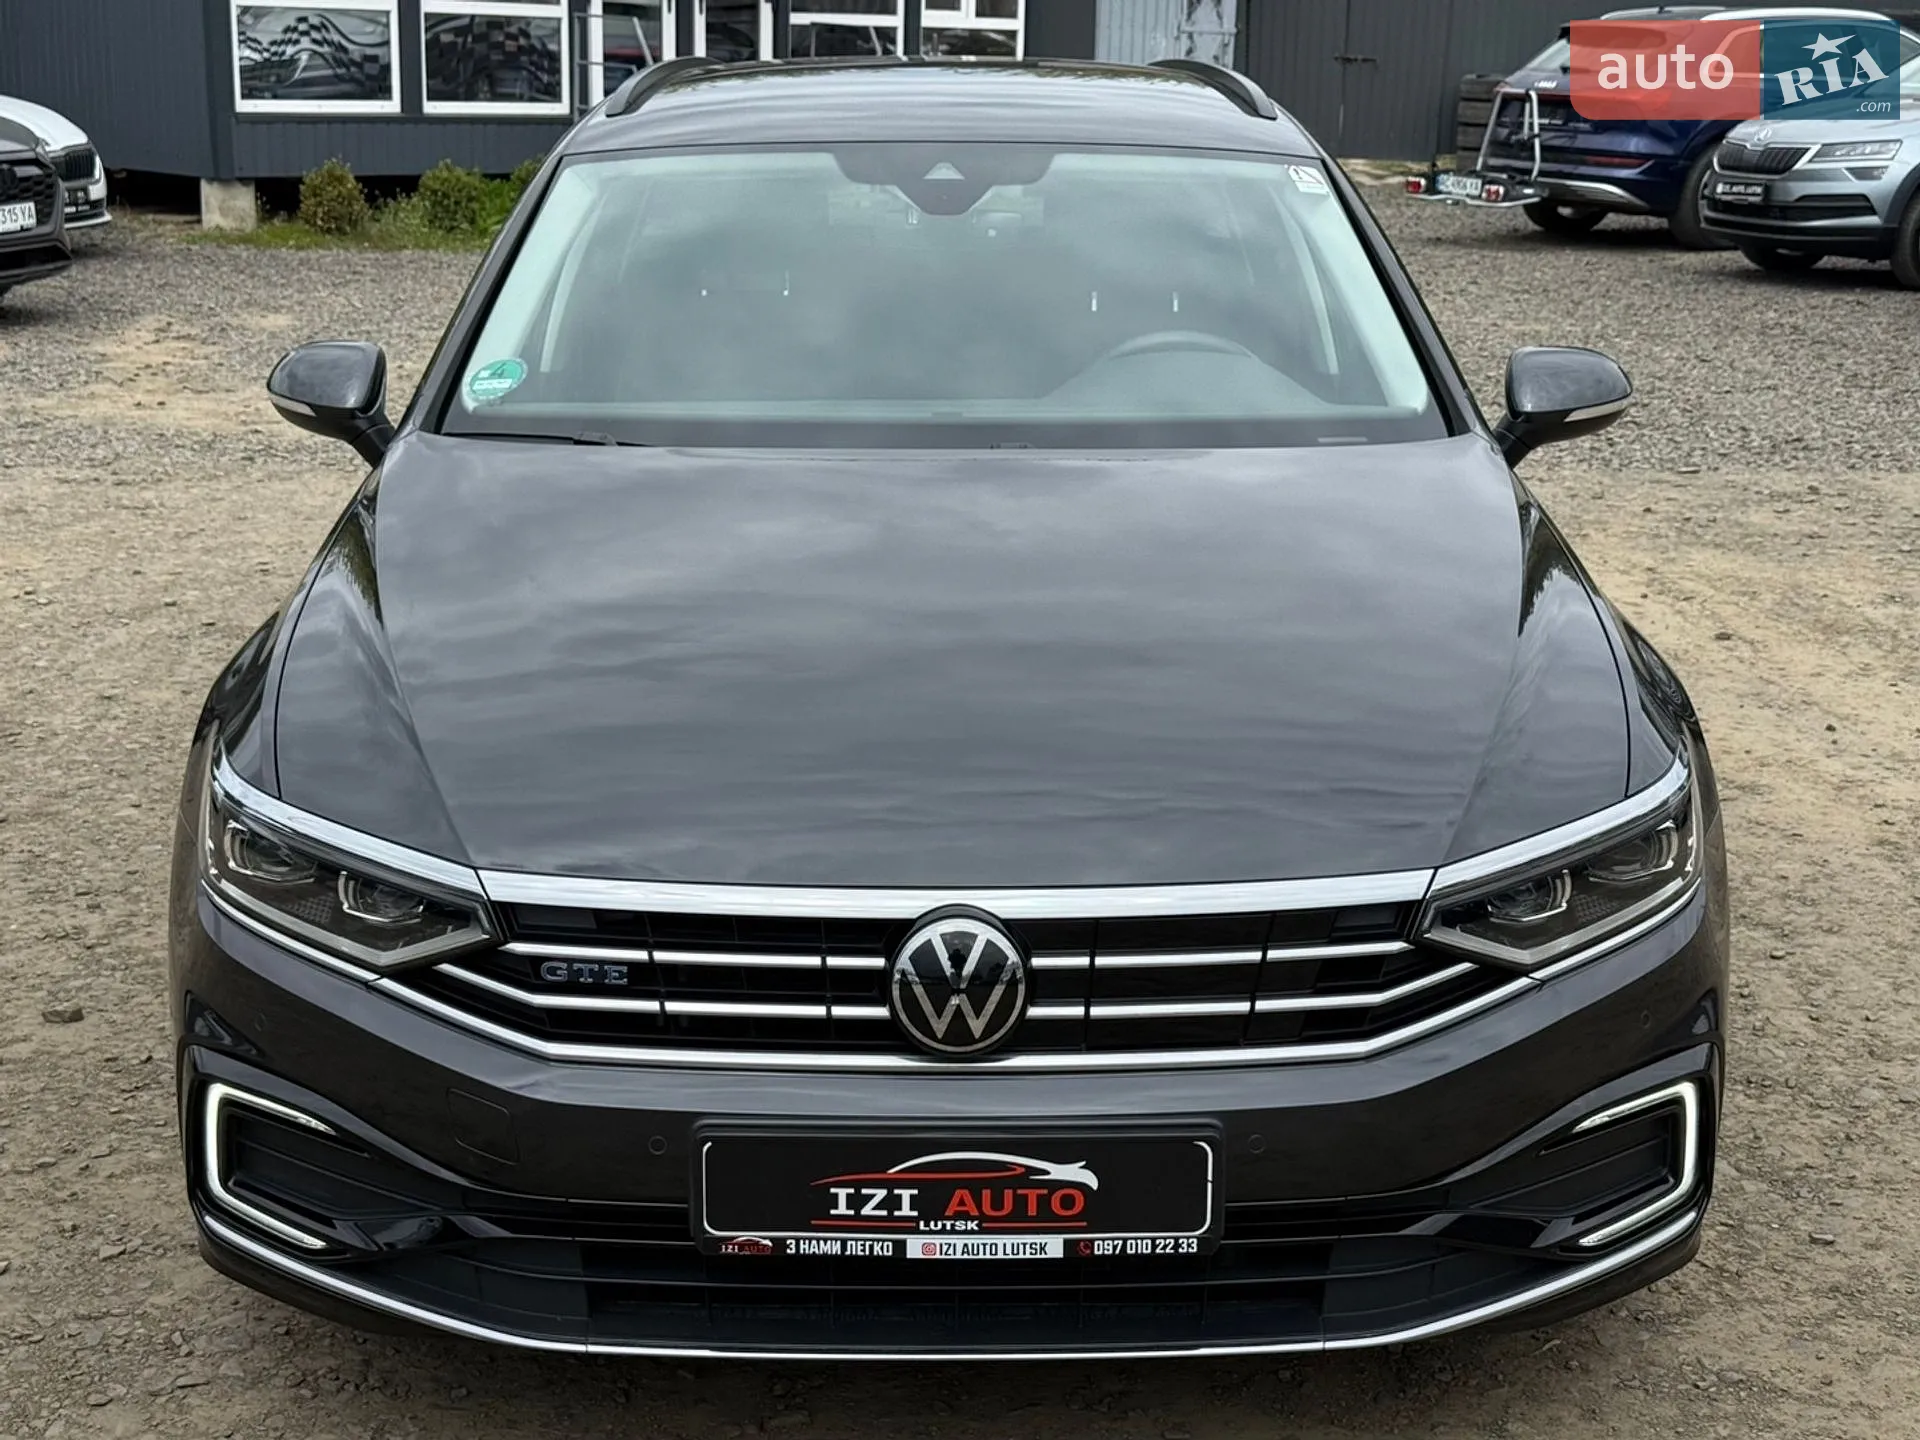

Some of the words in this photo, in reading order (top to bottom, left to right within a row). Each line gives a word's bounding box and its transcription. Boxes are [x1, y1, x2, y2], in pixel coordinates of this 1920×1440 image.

[540, 961, 628, 985] GTE
[829, 1187, 919, 1216] IZI
[944, 1188, 1085, 1216] AUTO
[919, 1220, 979, 1230] LUTSK
[800, 1239, 841, 1256] НАМИ
[845, 1240, 893, 1256] ЛЕГКО
[939, 1243, 956, 1256] IZI
[961, 1242, 998, 1256] AUTO
[1003, 1242, 1048, 1255] LUTSK
[1094, 1239, 1122, 1254] 097
[1127, 1239, 1150, 1254] 010
[1155, 1239, 1175, 1253] 22
[1179, 1238, 1198, 1252] 33
